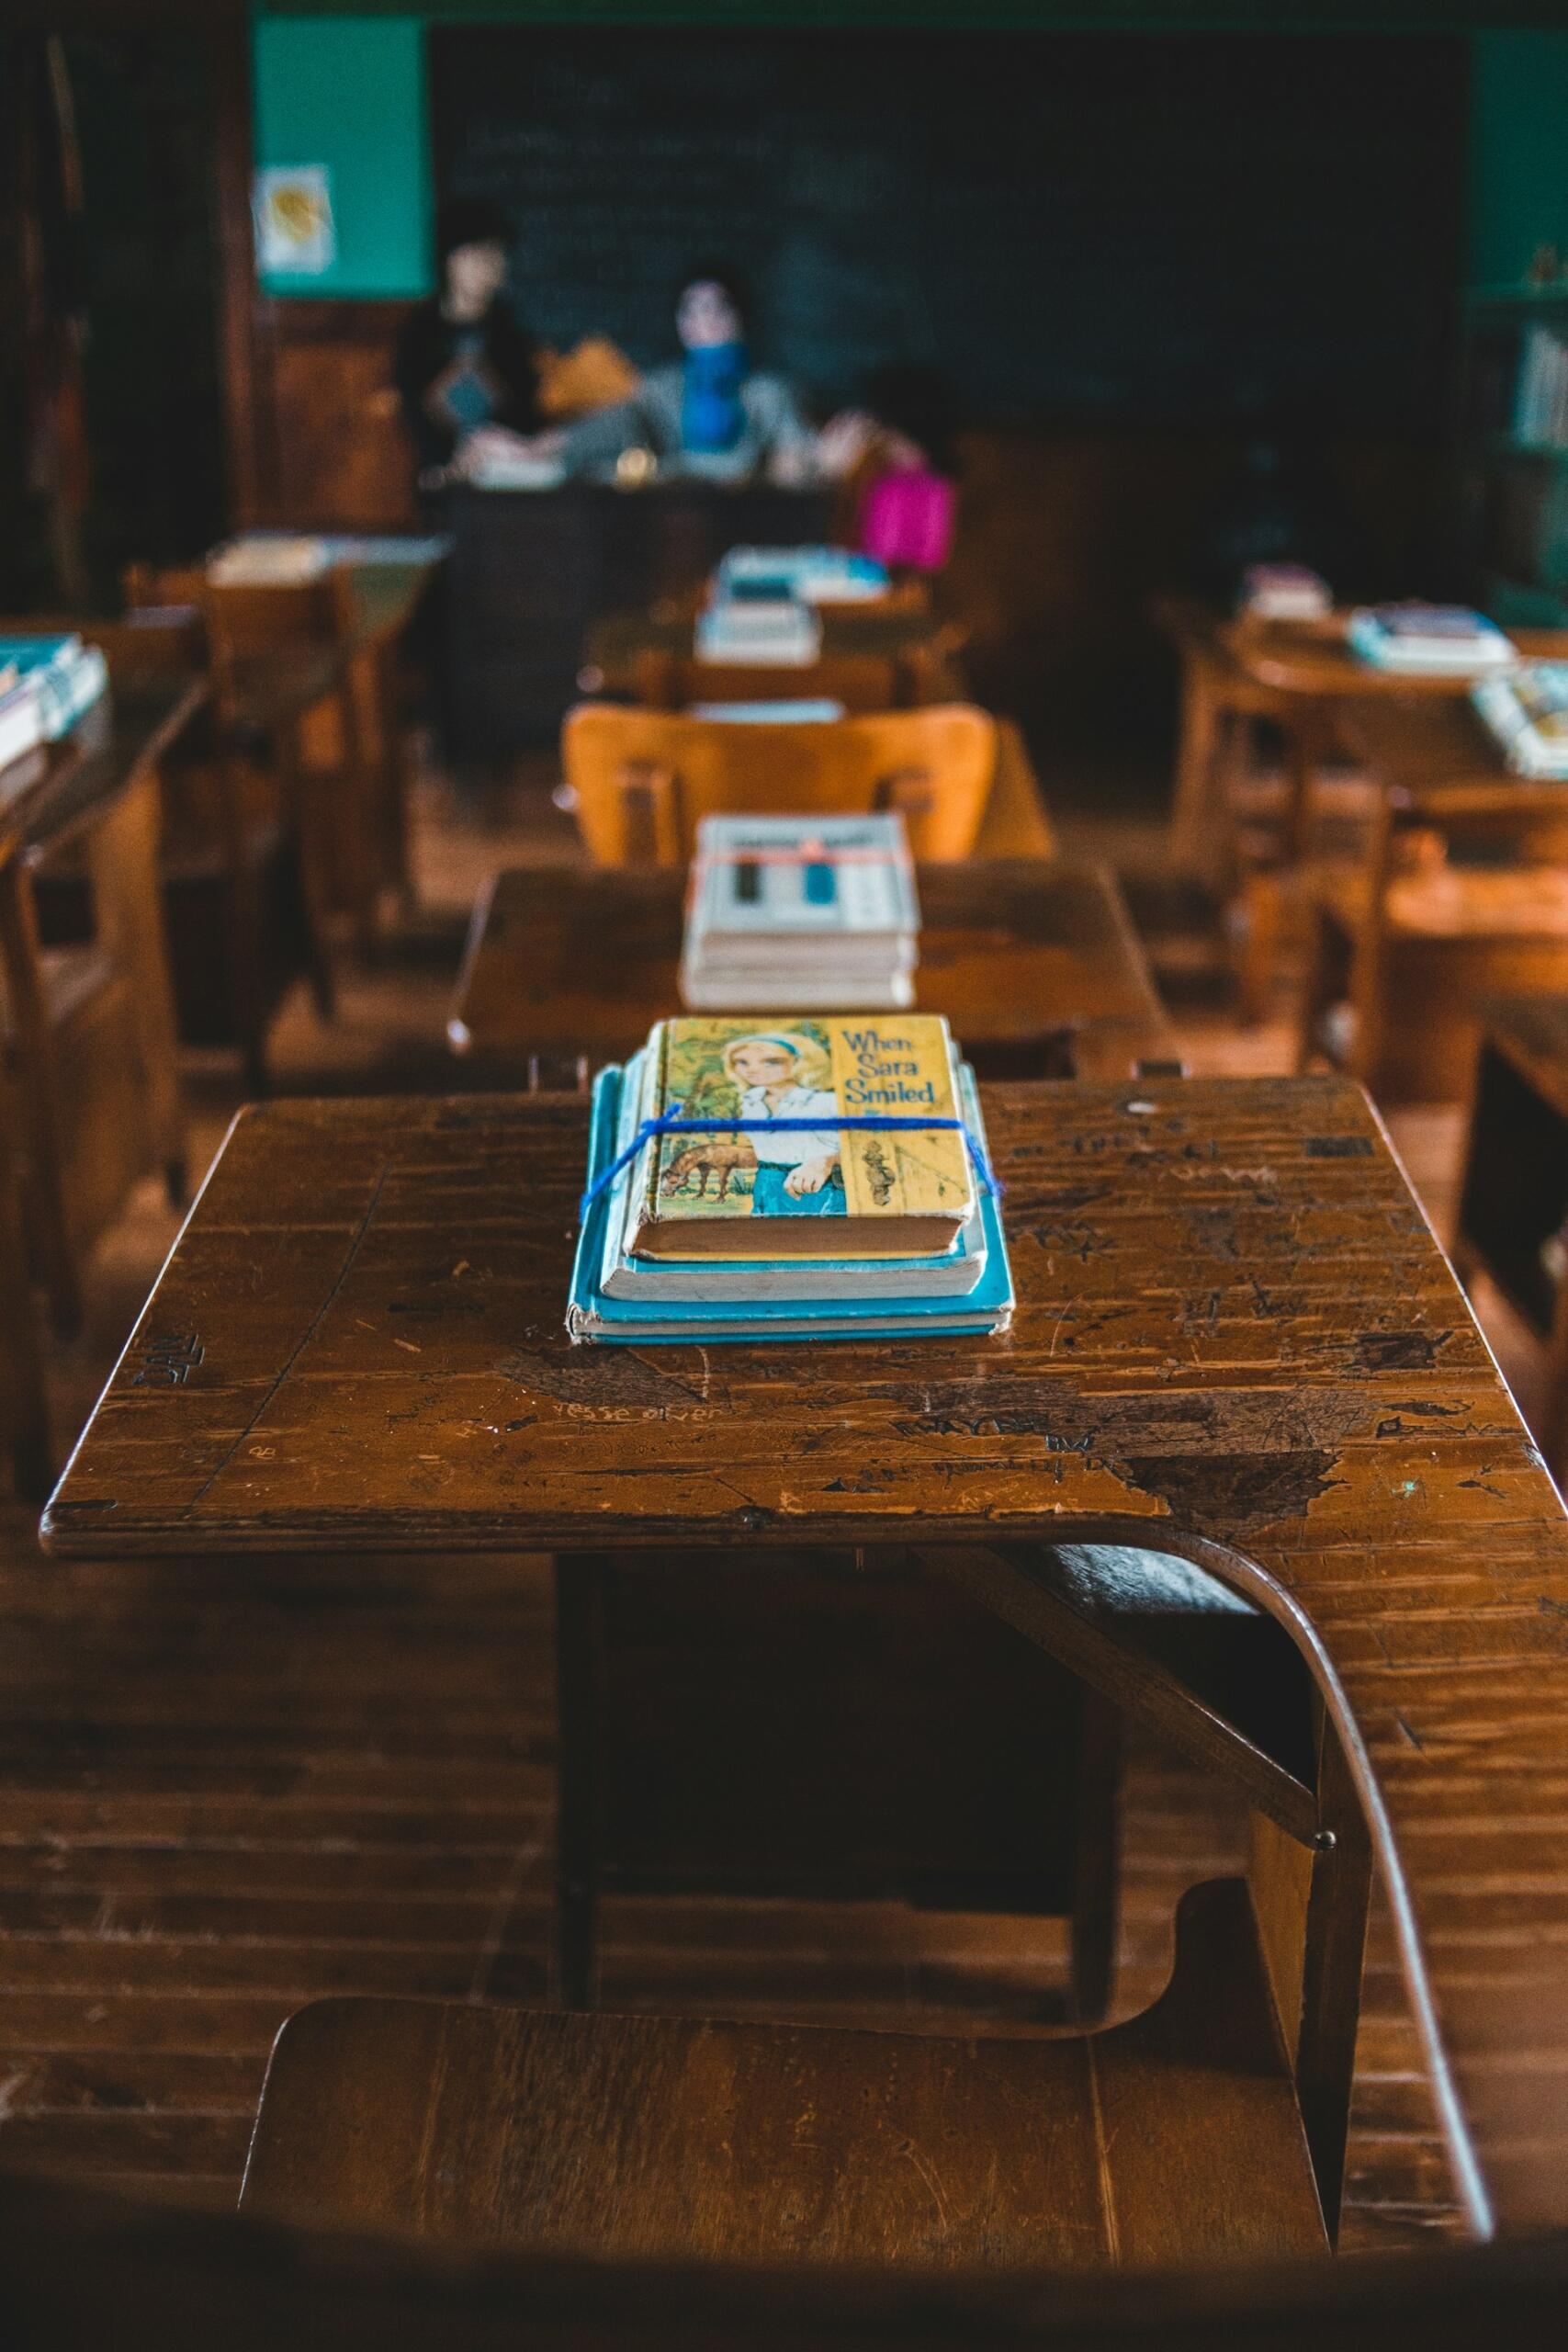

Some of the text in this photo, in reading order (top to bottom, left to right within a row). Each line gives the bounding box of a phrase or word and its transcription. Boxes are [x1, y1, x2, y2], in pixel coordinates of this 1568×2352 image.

[842, 1029, 912, 1052] When
[857, 1053, 918, 1078] Sara
[844, 1078, 935, 1104] Smiled
